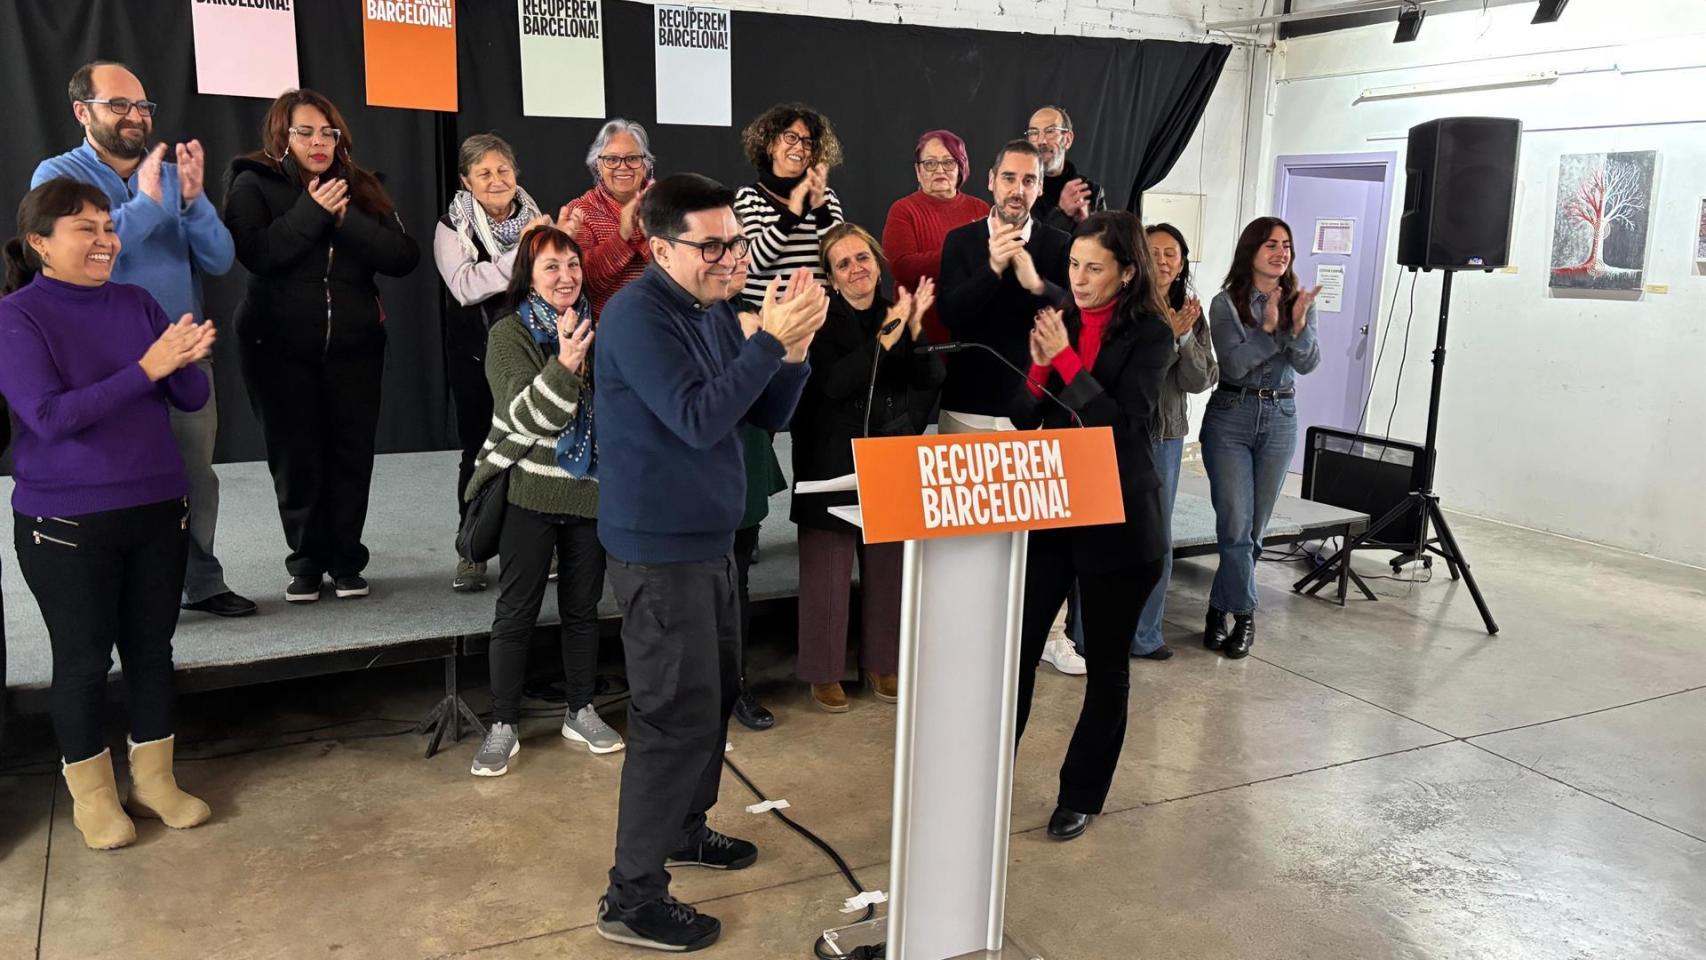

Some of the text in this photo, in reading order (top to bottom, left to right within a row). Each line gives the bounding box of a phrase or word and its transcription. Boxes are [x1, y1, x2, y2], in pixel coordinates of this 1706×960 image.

[367, 0, 452, 28] BARCELONA!
[523, 0, 598, 19] RECUPEREM
[659, 9, 727, 31] RECUPEREM
[523, 16, 600, 39] BARCELONA!
[659, 28, 728, 50] BARCELONA!
[917, 439, 1065, 486] RECUPEREM
[921, 480, 1072, 529] BARCELONA!
